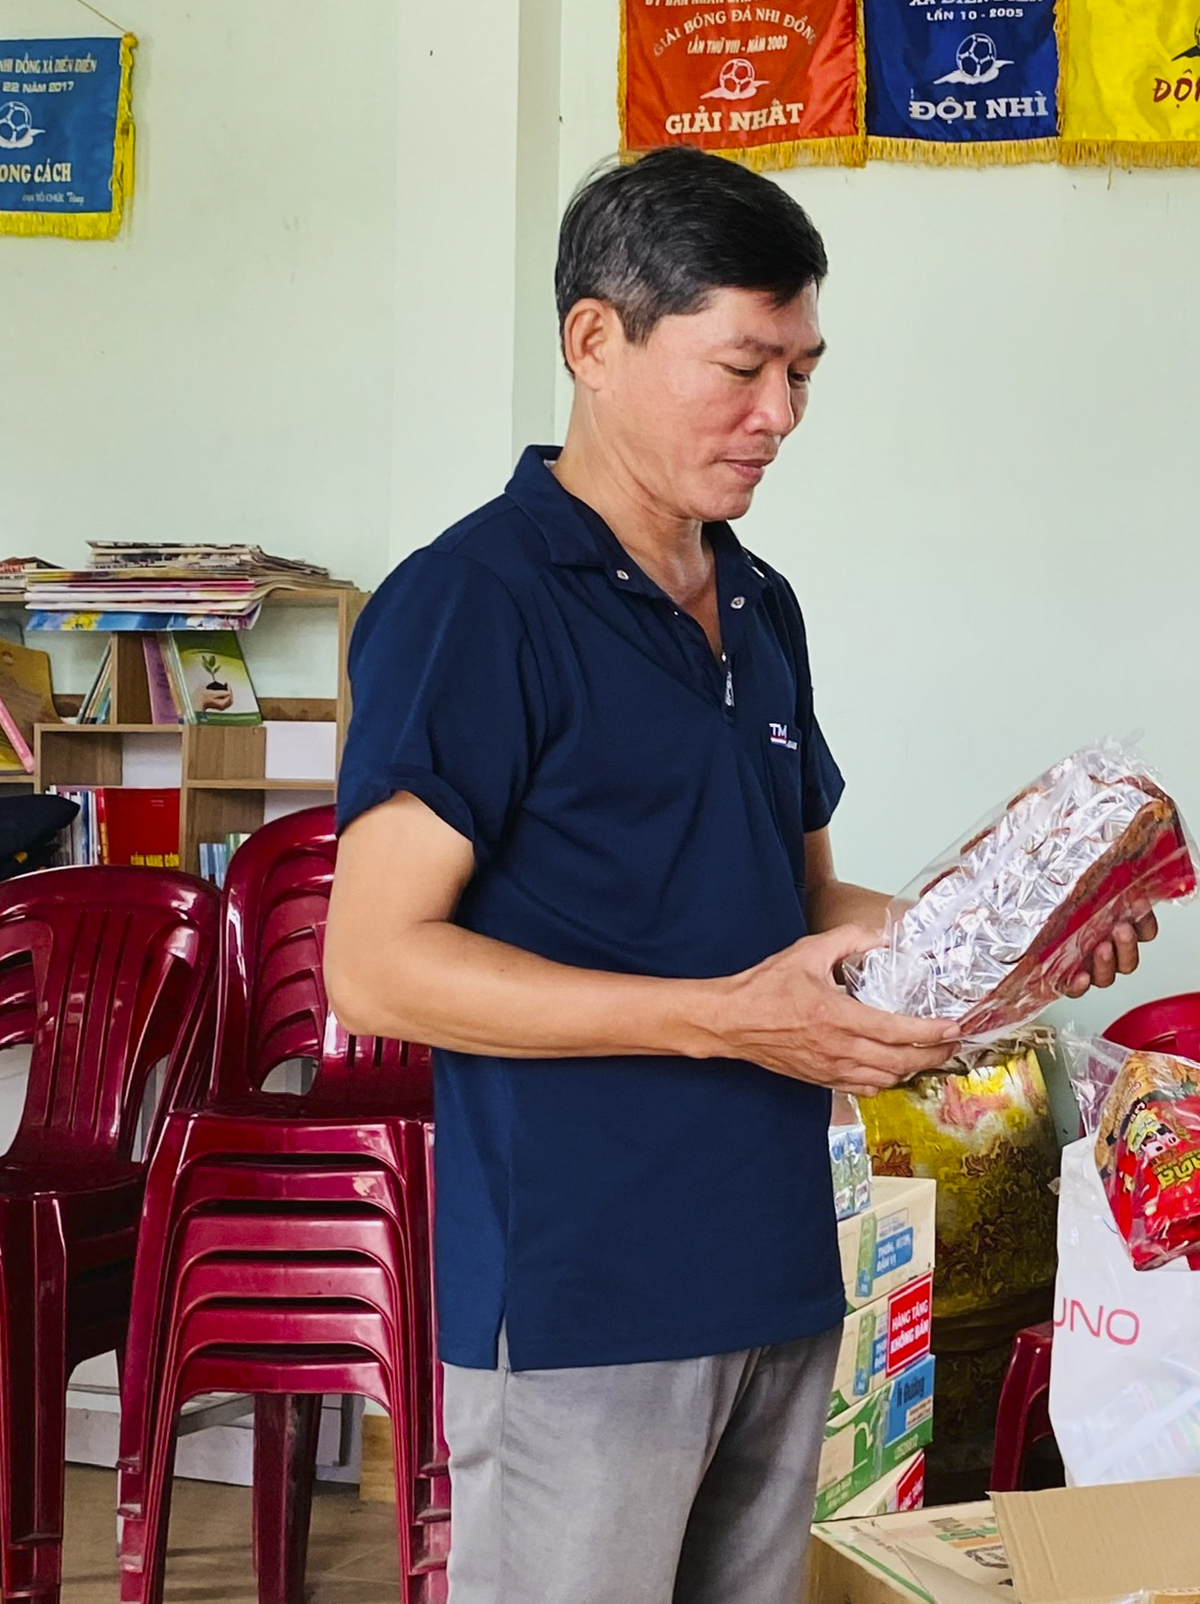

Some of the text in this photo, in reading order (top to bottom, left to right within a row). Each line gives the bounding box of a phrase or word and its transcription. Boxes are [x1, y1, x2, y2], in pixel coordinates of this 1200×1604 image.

[926, 8, 954, 21] LẦN
[960, 10, 977, 20] 10
[990, 8, 1024, 18] 2005
[653, 4, 816, 57] GIẢI BÓNG ĐÁ NHI ĐỒNG
[687, 34, 705, 54] LẦN
[767, 34, 788, 51] 2003
[666, 98, 804, 134] GIẢI NHẤT
[908, 90, 1048, 124] ĐỘI NHÌ
[34, 158, 72, 183] CÁCH
[769, 723, 788, 739] TM
[892, 1309, 911, 1332] HÀNG
